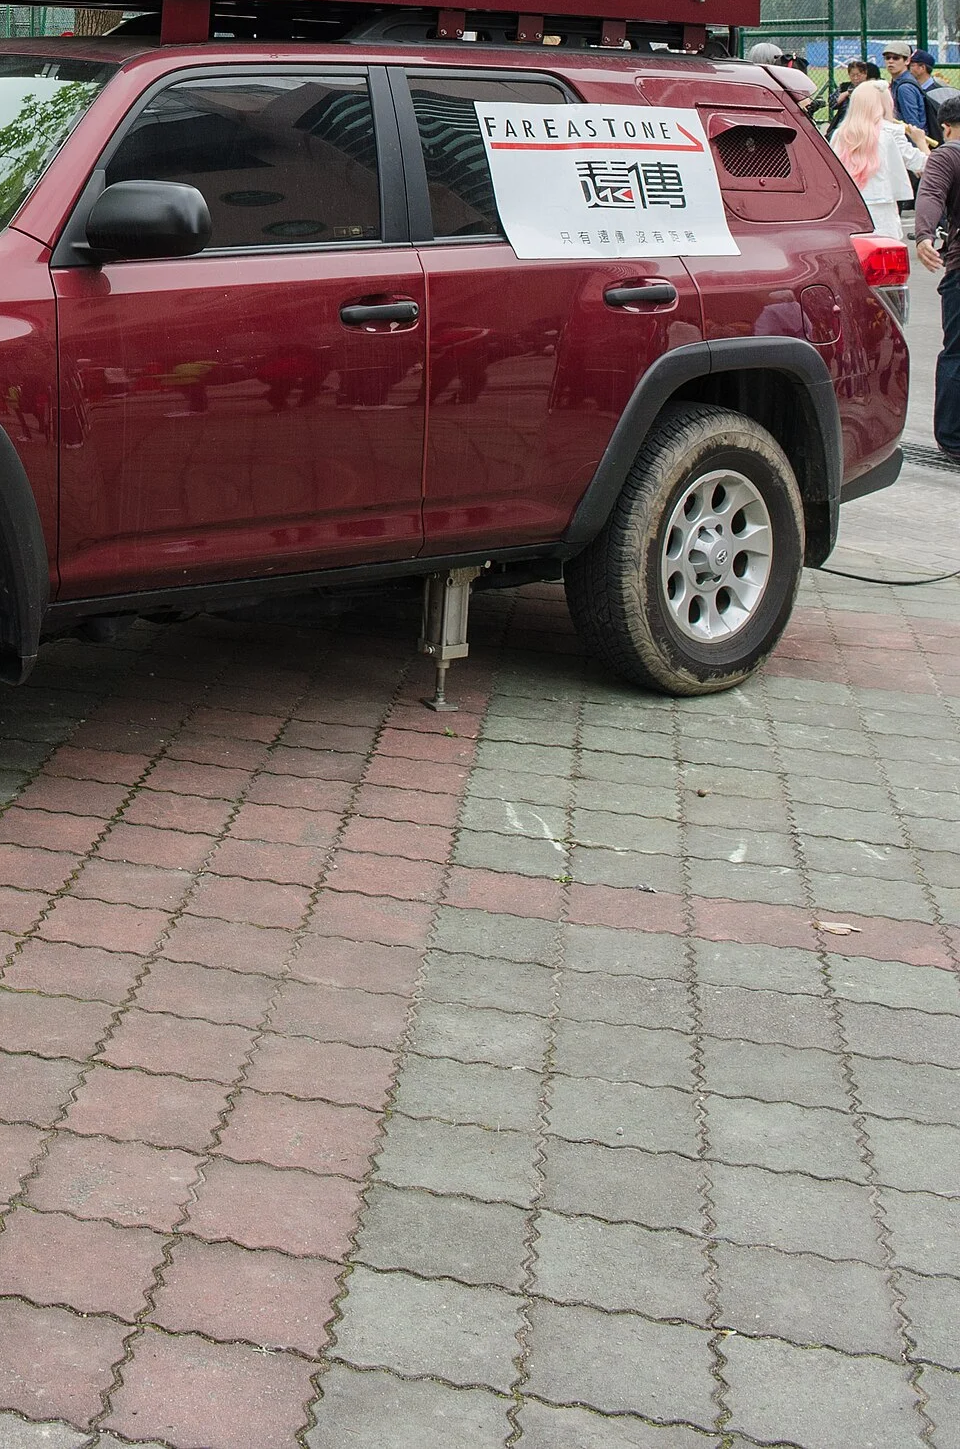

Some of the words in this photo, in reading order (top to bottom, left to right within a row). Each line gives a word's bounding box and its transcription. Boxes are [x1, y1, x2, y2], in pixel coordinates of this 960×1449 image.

[483, 116, 672, 140] FAREASTONE
[575, 160, 687, 209] 遠傳
[560, 229, 625, 245] 只有遠傳
